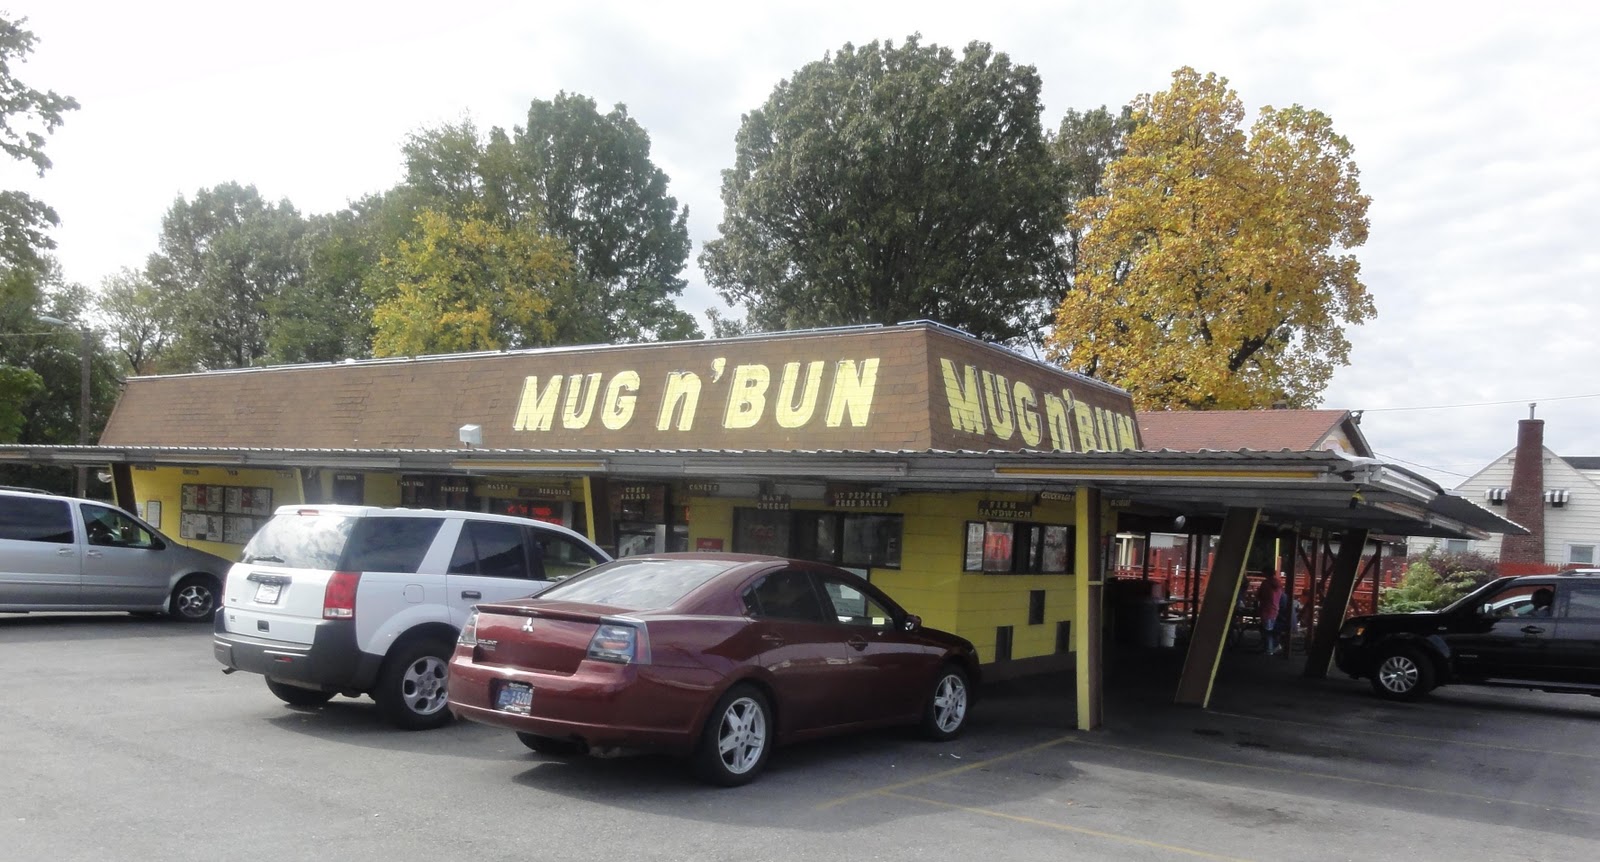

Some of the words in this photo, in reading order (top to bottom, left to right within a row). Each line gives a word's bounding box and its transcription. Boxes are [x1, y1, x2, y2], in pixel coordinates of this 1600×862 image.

[512, 369, 641, 432] MUG
[939, 357, 1043, 447] MUG
[848, 491, 883, 500] PEPPER
[756, 501, 790, 510] CHEESE
[859, 499, 889, 508] BALLS
[988, 500, 1017, 509] FISH
[978, 508, 1032, 519] SANDWICH
